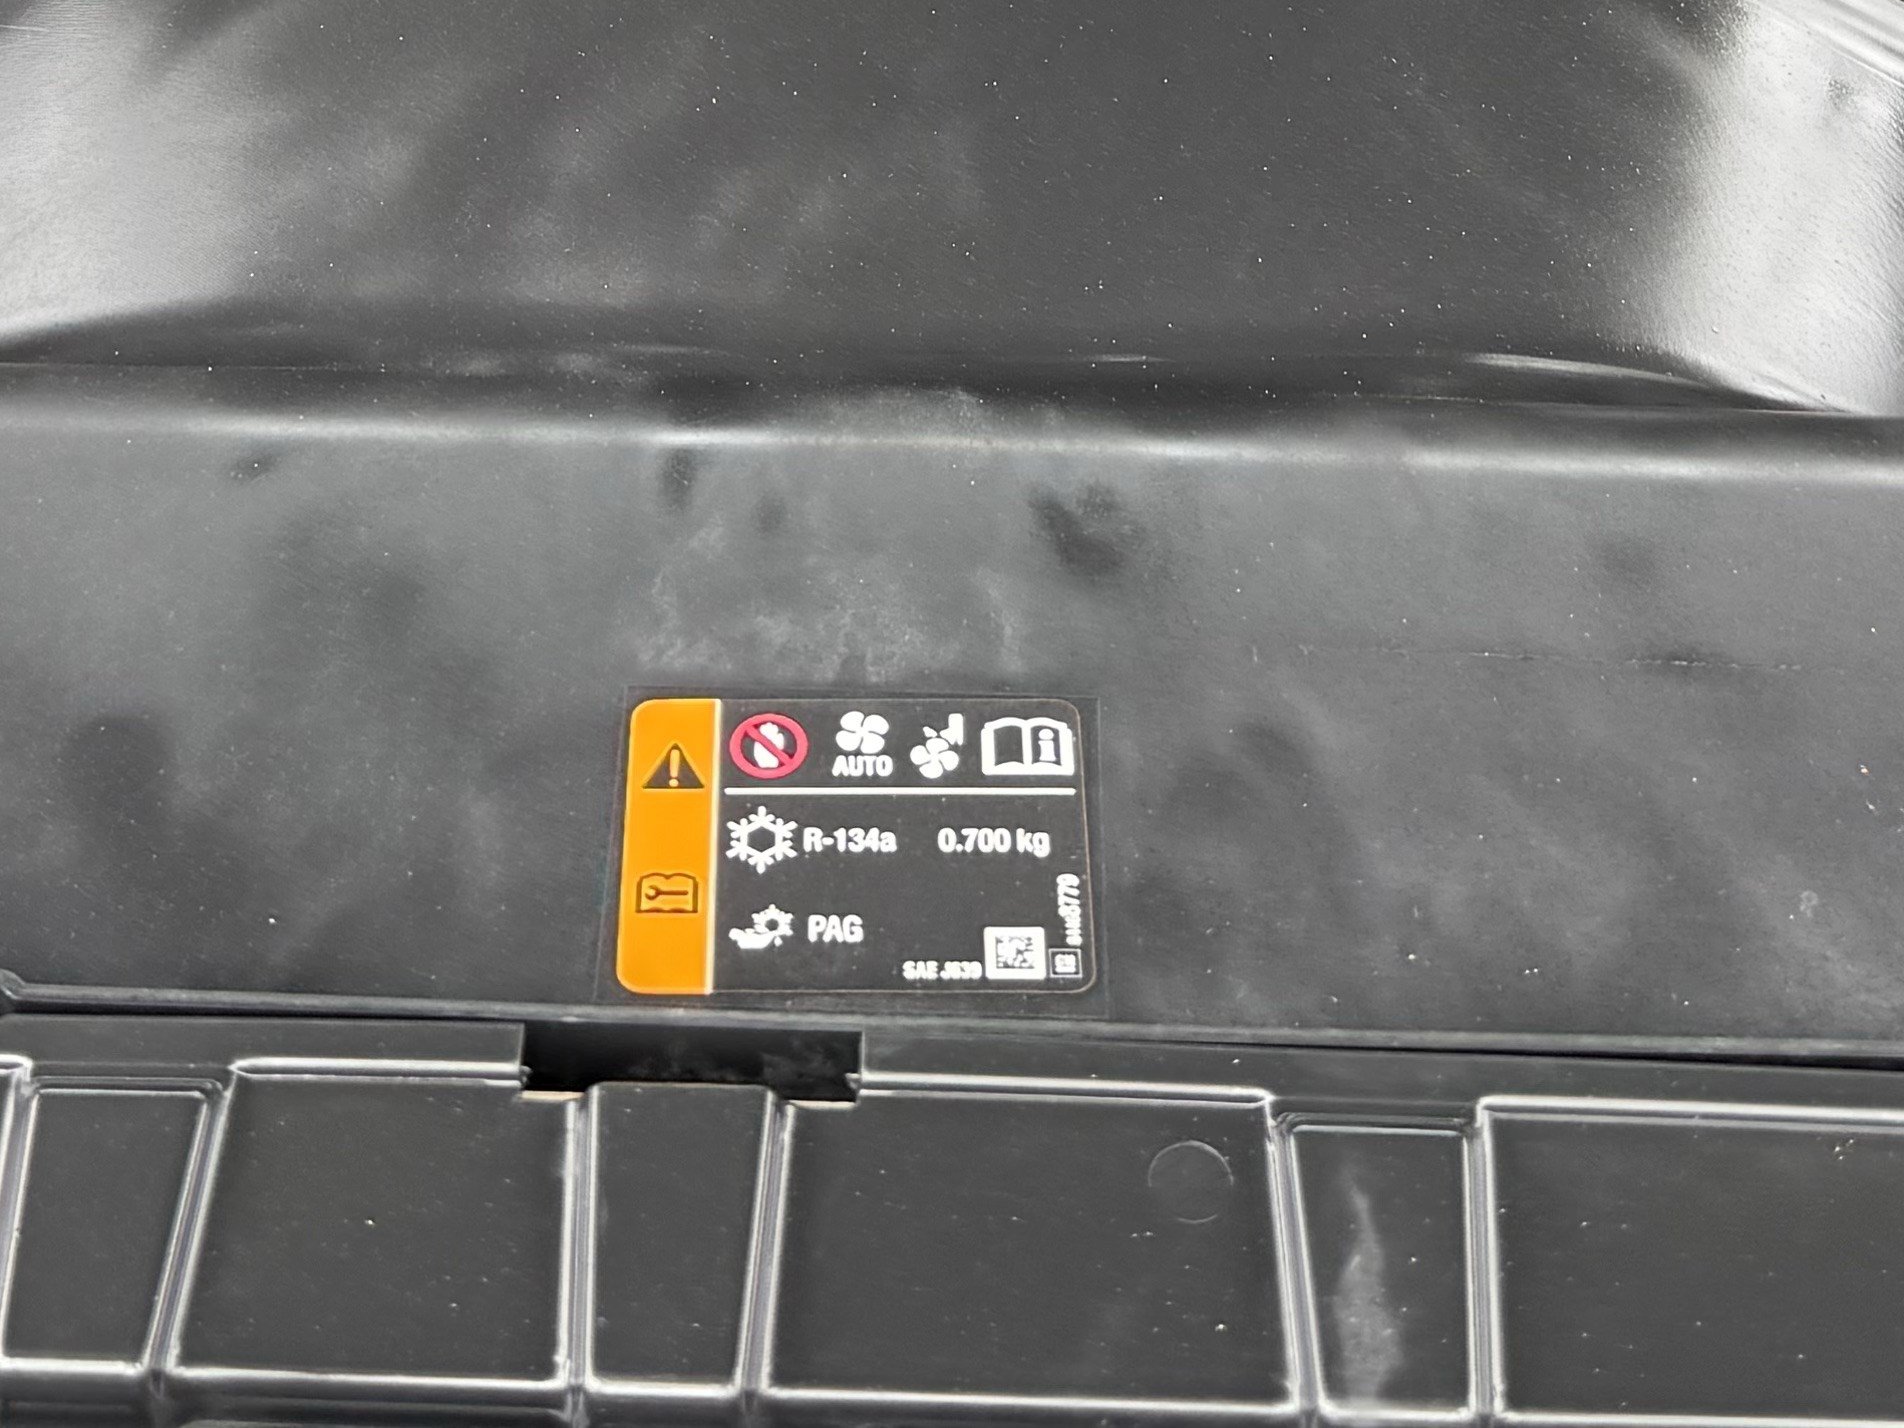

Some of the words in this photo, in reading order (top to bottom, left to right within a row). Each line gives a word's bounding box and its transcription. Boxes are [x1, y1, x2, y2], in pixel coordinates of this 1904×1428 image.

[832, 755, 894, 777] AUTO
[802, 826, 897, 853] R-134a
[937, 827, 1012, 853] 0.700
[1015, 827, 1051, 858] kg
[807, 914, 865, 944] PAG
[902, 960, 939, 980] SAE
